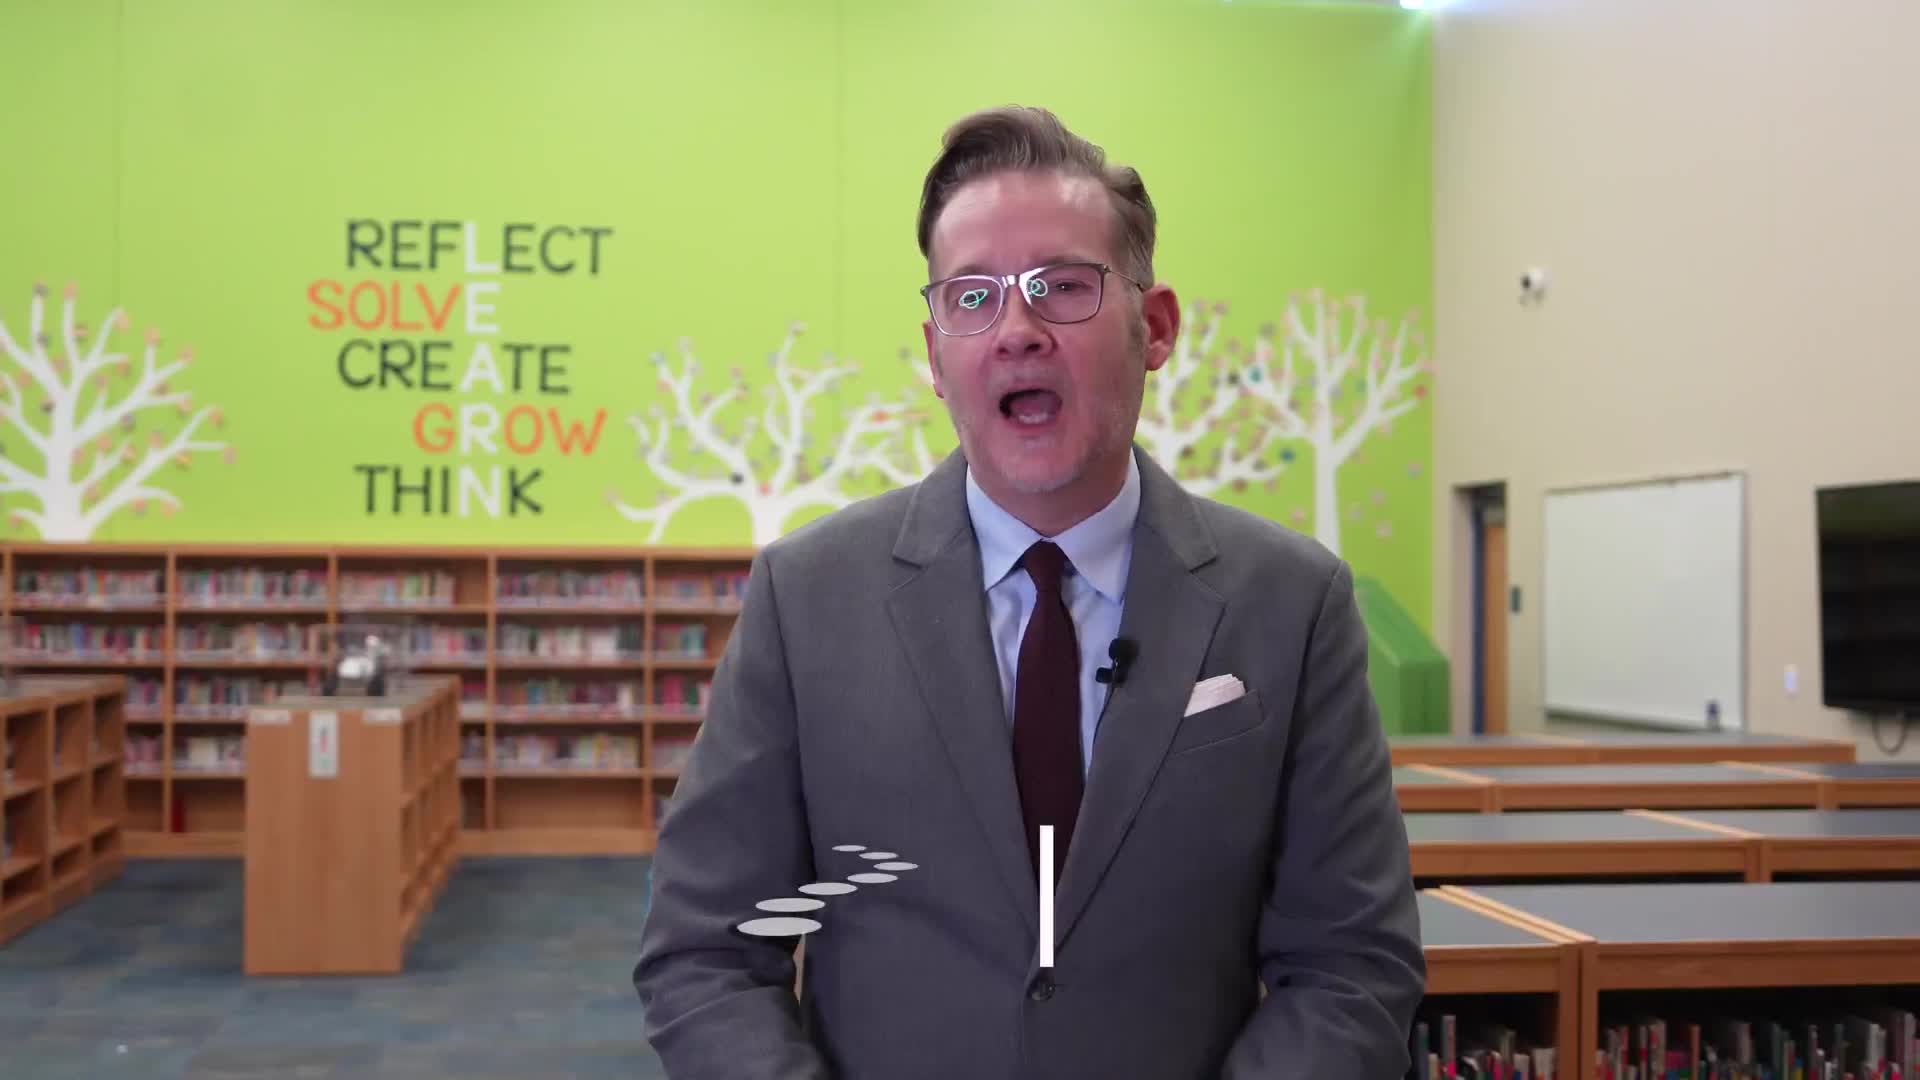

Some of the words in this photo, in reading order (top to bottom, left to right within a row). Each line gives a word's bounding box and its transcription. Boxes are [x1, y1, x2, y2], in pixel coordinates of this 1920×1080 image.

[347, 219, 613, 275] REFLECT
[307, 279, 499, 333] SOLVE
[337, 338, 571, 395] CREATE
[412, 402, 607, 455] GROW
[354, 464, 543, 518] THINK
